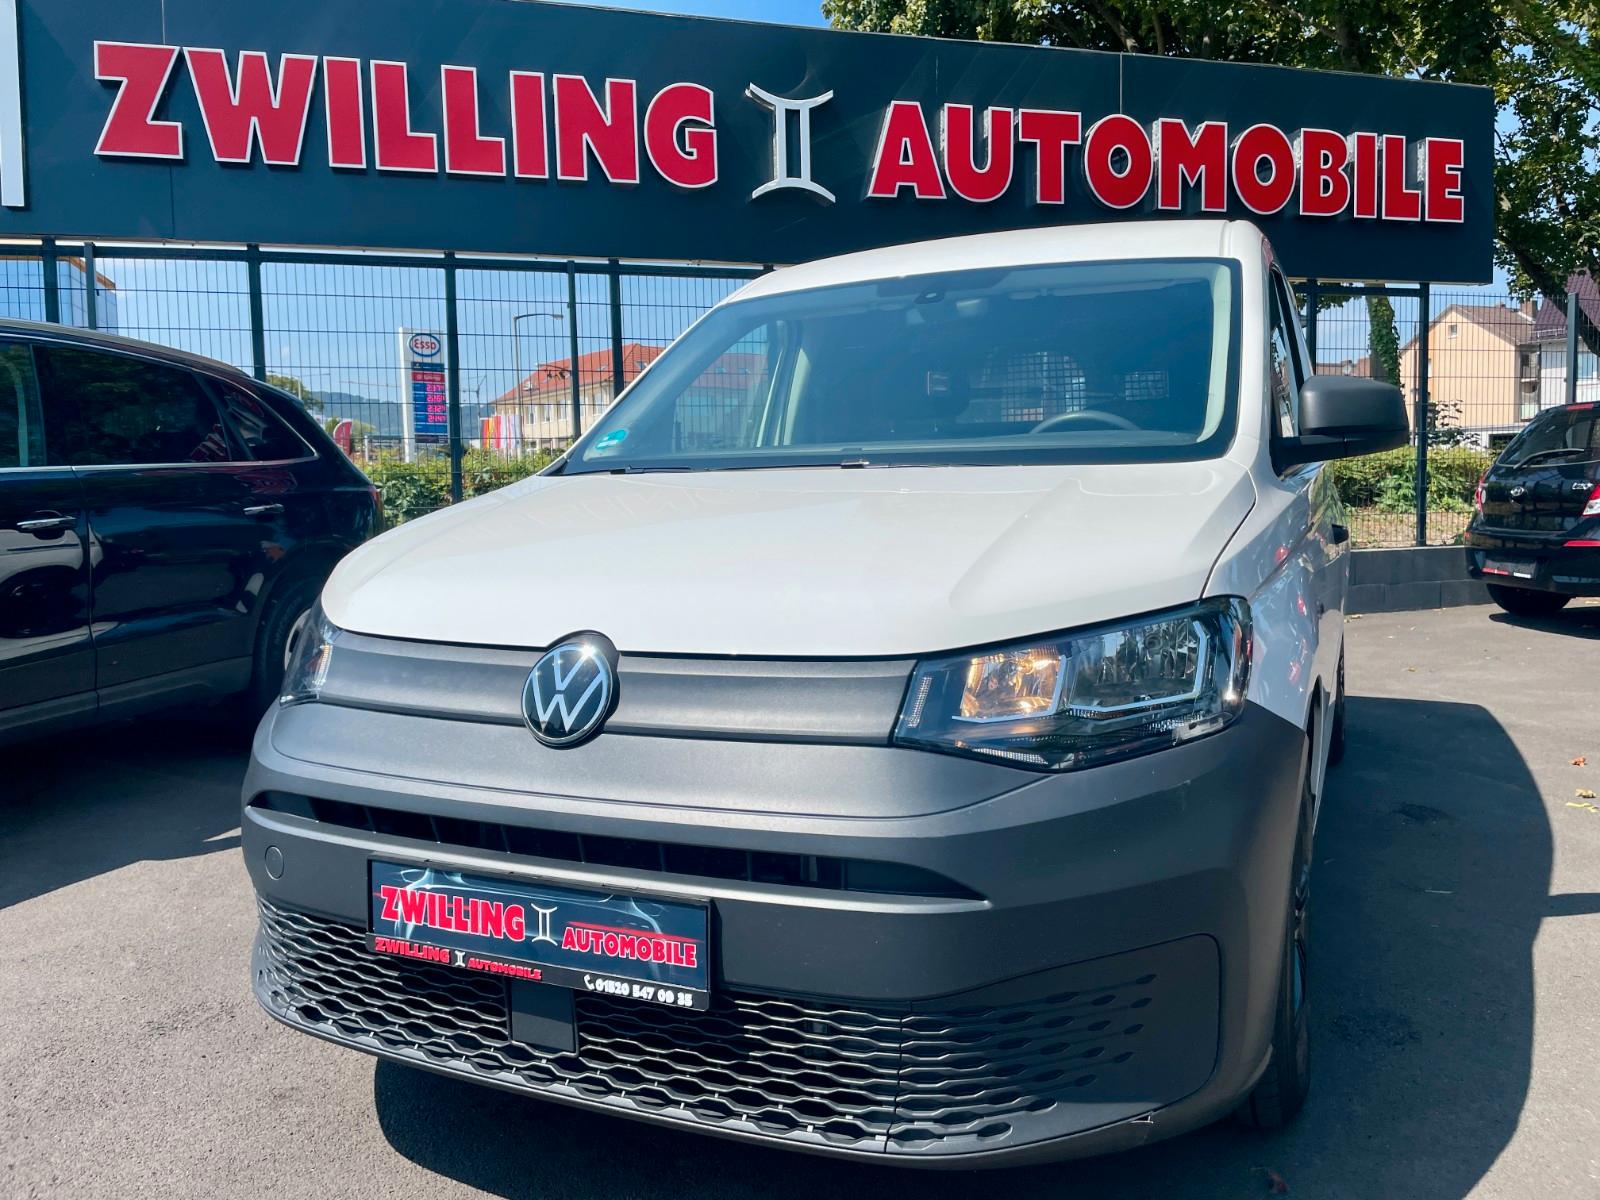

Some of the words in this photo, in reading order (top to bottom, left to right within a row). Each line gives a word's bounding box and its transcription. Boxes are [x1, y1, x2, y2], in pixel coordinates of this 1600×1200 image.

[93, 40, 718, 189] ZWILLING
[867, 100, 1465, 223] AUTOMOBILE
[380, 884, 526, 942] ZWILLING
[562, 926, 698, 968] AUTOMOBILE
[375, 937, 450, 963] ZWILLING
[467, 957, 542, 980] AUTOMOBILE
[595, 978, 630, 996] 01520
[632, 984, 655, 1000] 547
